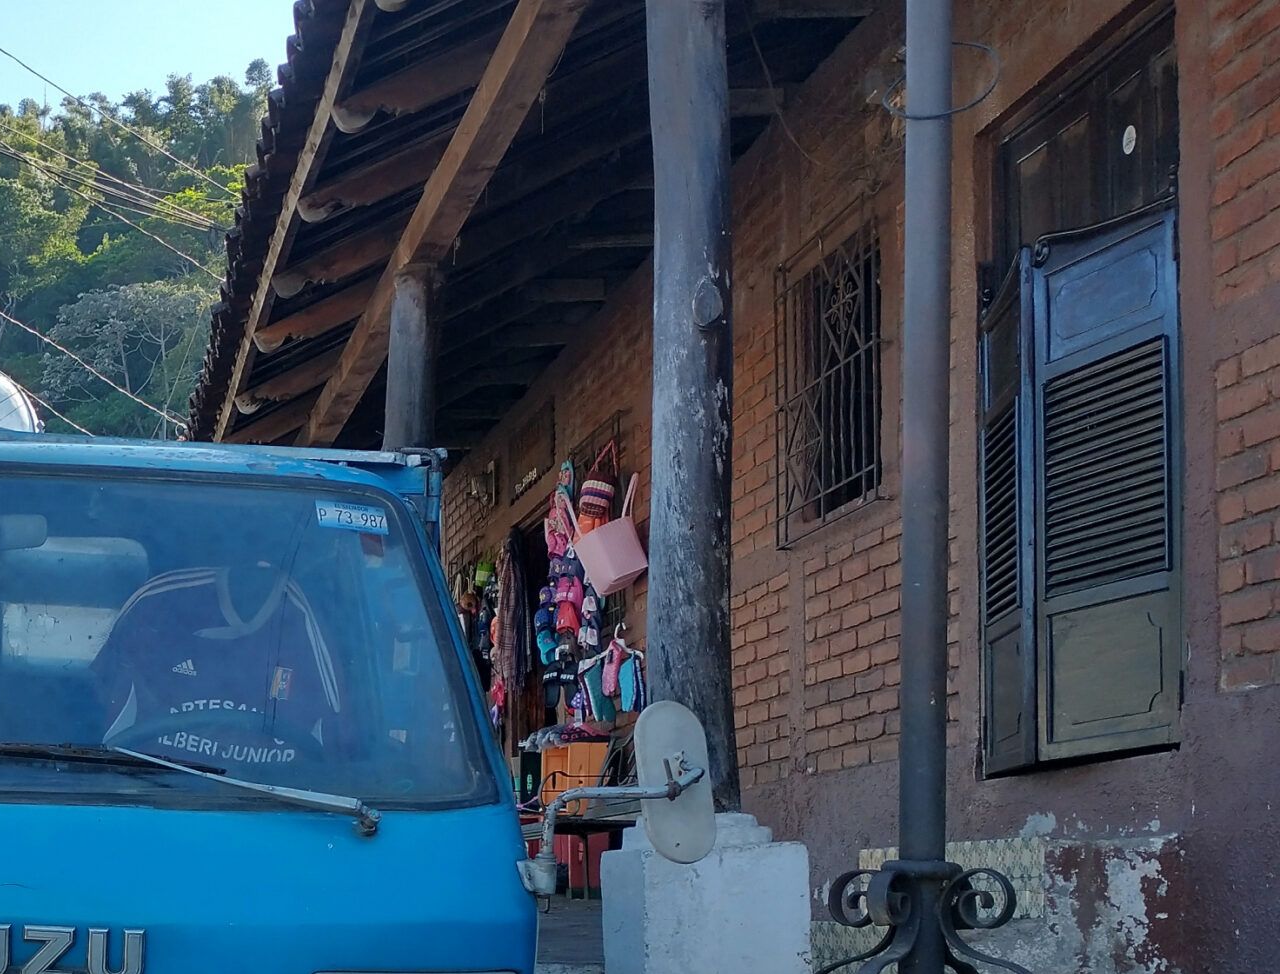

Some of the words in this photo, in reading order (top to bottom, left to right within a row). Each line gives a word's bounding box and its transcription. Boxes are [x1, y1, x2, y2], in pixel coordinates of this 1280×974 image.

[319, 508, 327, 521] P
[335, 509, 353, 525] 73
[360, 513, 384, 528] 987
